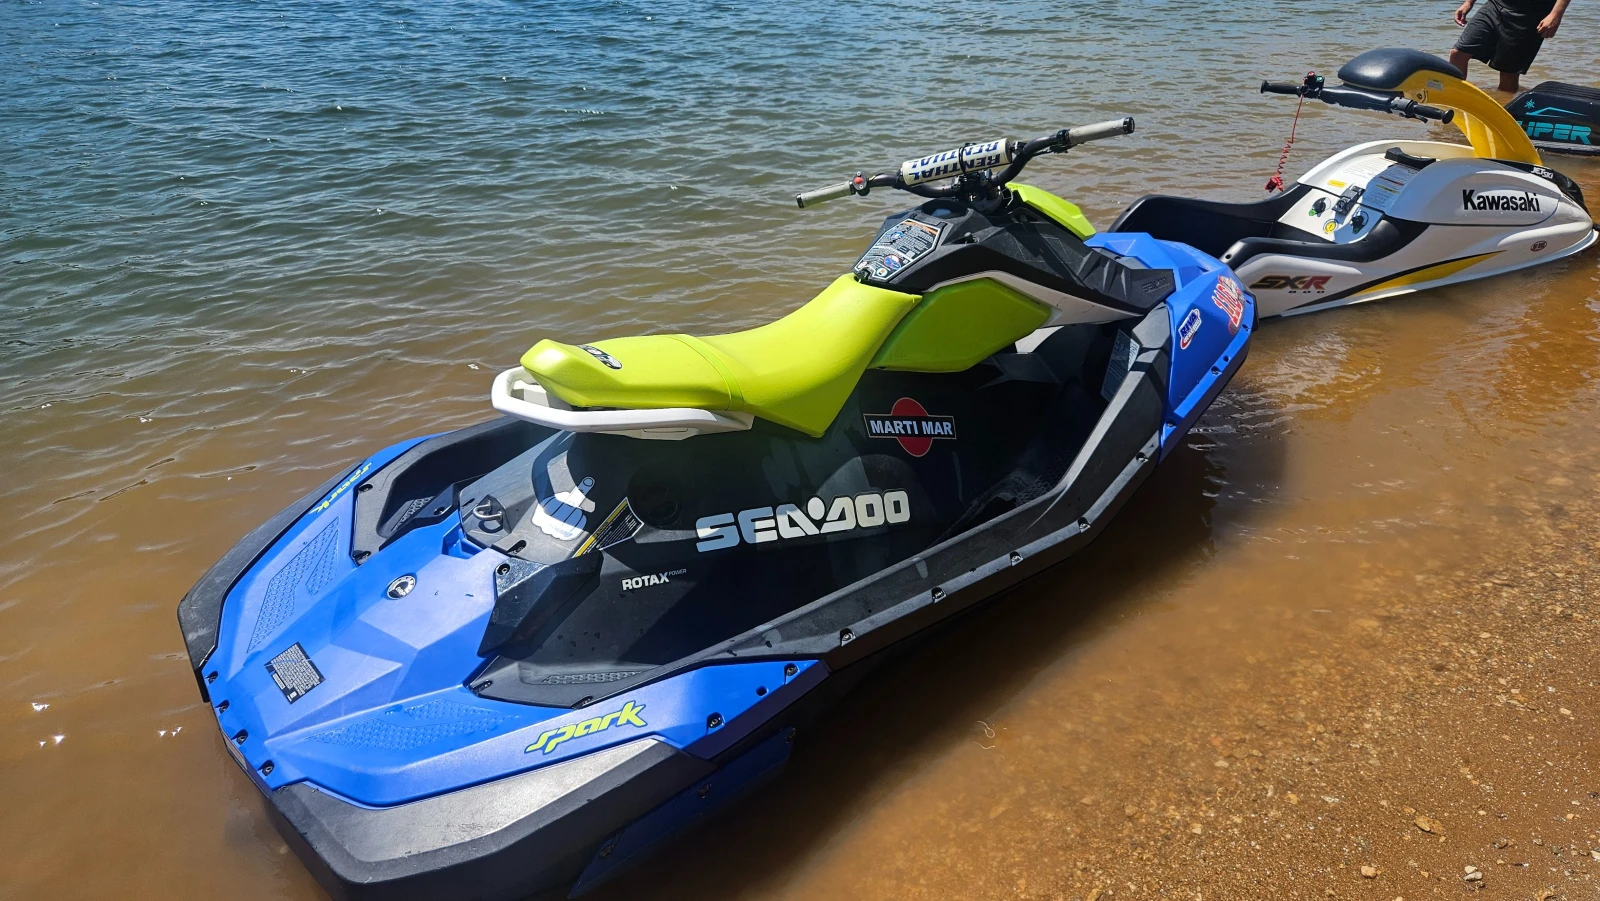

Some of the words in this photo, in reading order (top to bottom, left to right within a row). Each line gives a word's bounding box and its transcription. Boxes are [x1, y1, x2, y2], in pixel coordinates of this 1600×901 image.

[1516, 120, 1592, 145] UPER
[909, 154, 1001, 180] RENTHAL
[1462, 189, 1541, 212] Kawasaki
[869, 420, 919, 434] MARTI
[921, 421, 953, 435] MAR
[621, 571, 670, 591] ROTAX
[668, 568, 687, 576] POWER
[524, 700, 648, 755] spark
